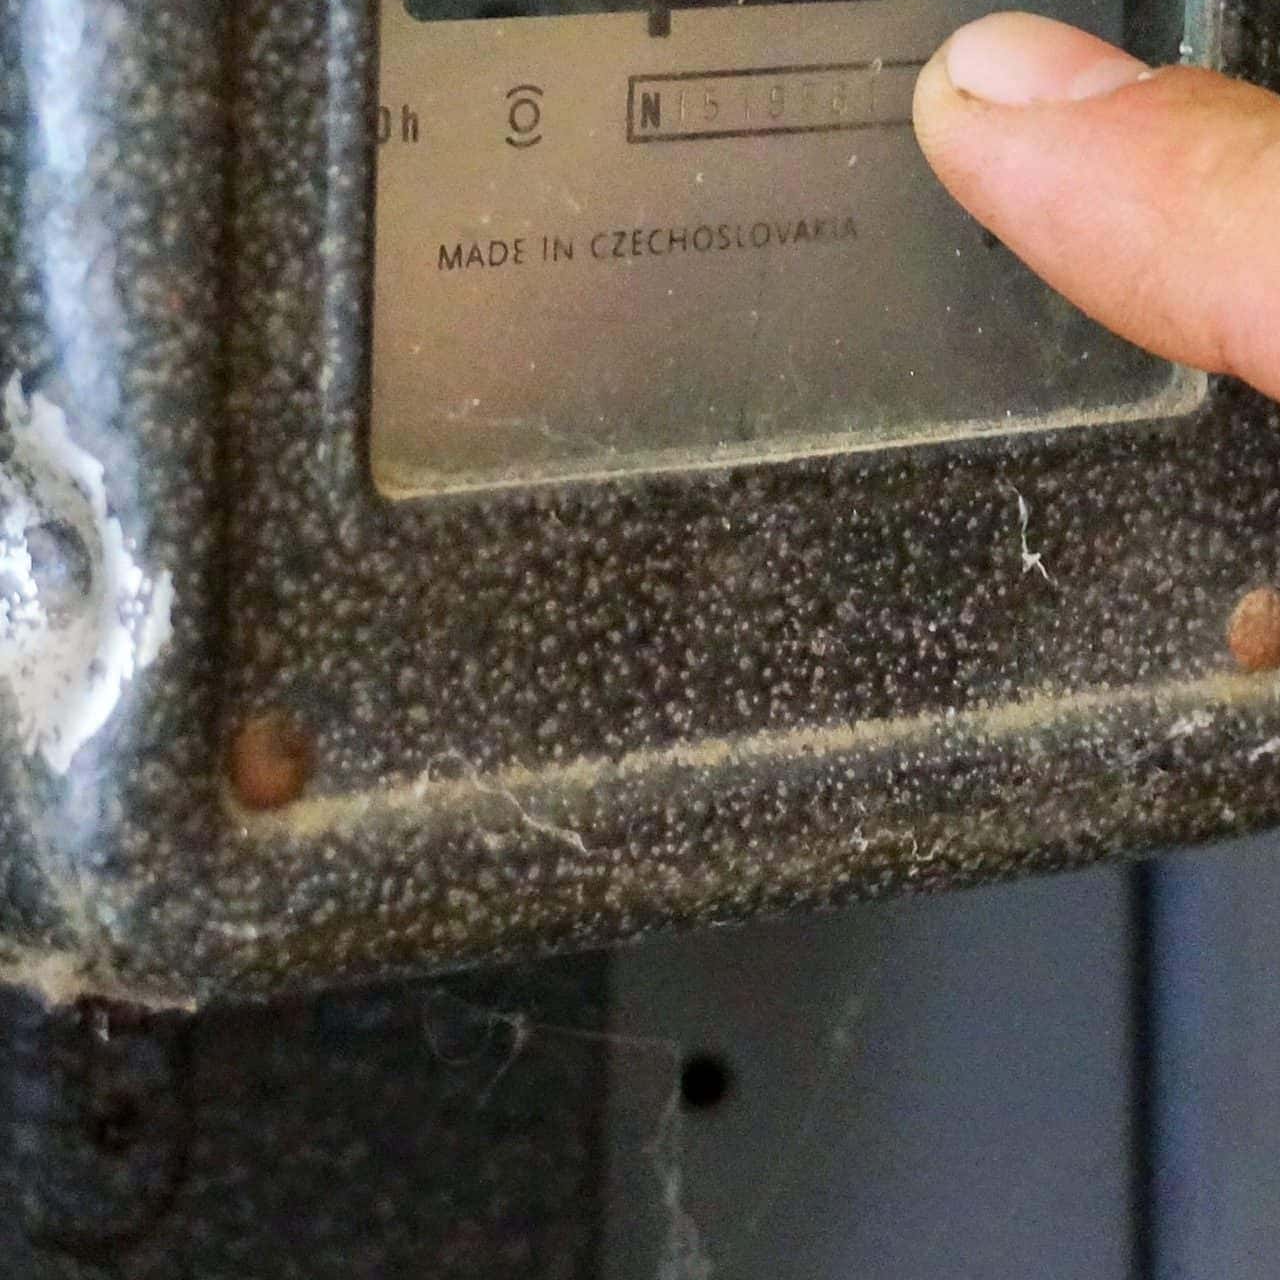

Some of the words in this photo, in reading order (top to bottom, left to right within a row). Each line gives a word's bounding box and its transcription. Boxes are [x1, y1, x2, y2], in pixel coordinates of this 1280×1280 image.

[437, 240, 526, 272] MADE
[541, 237, 574, 263] IN
[590, 216, 859, 260] CZECHOSLOVAKIA
